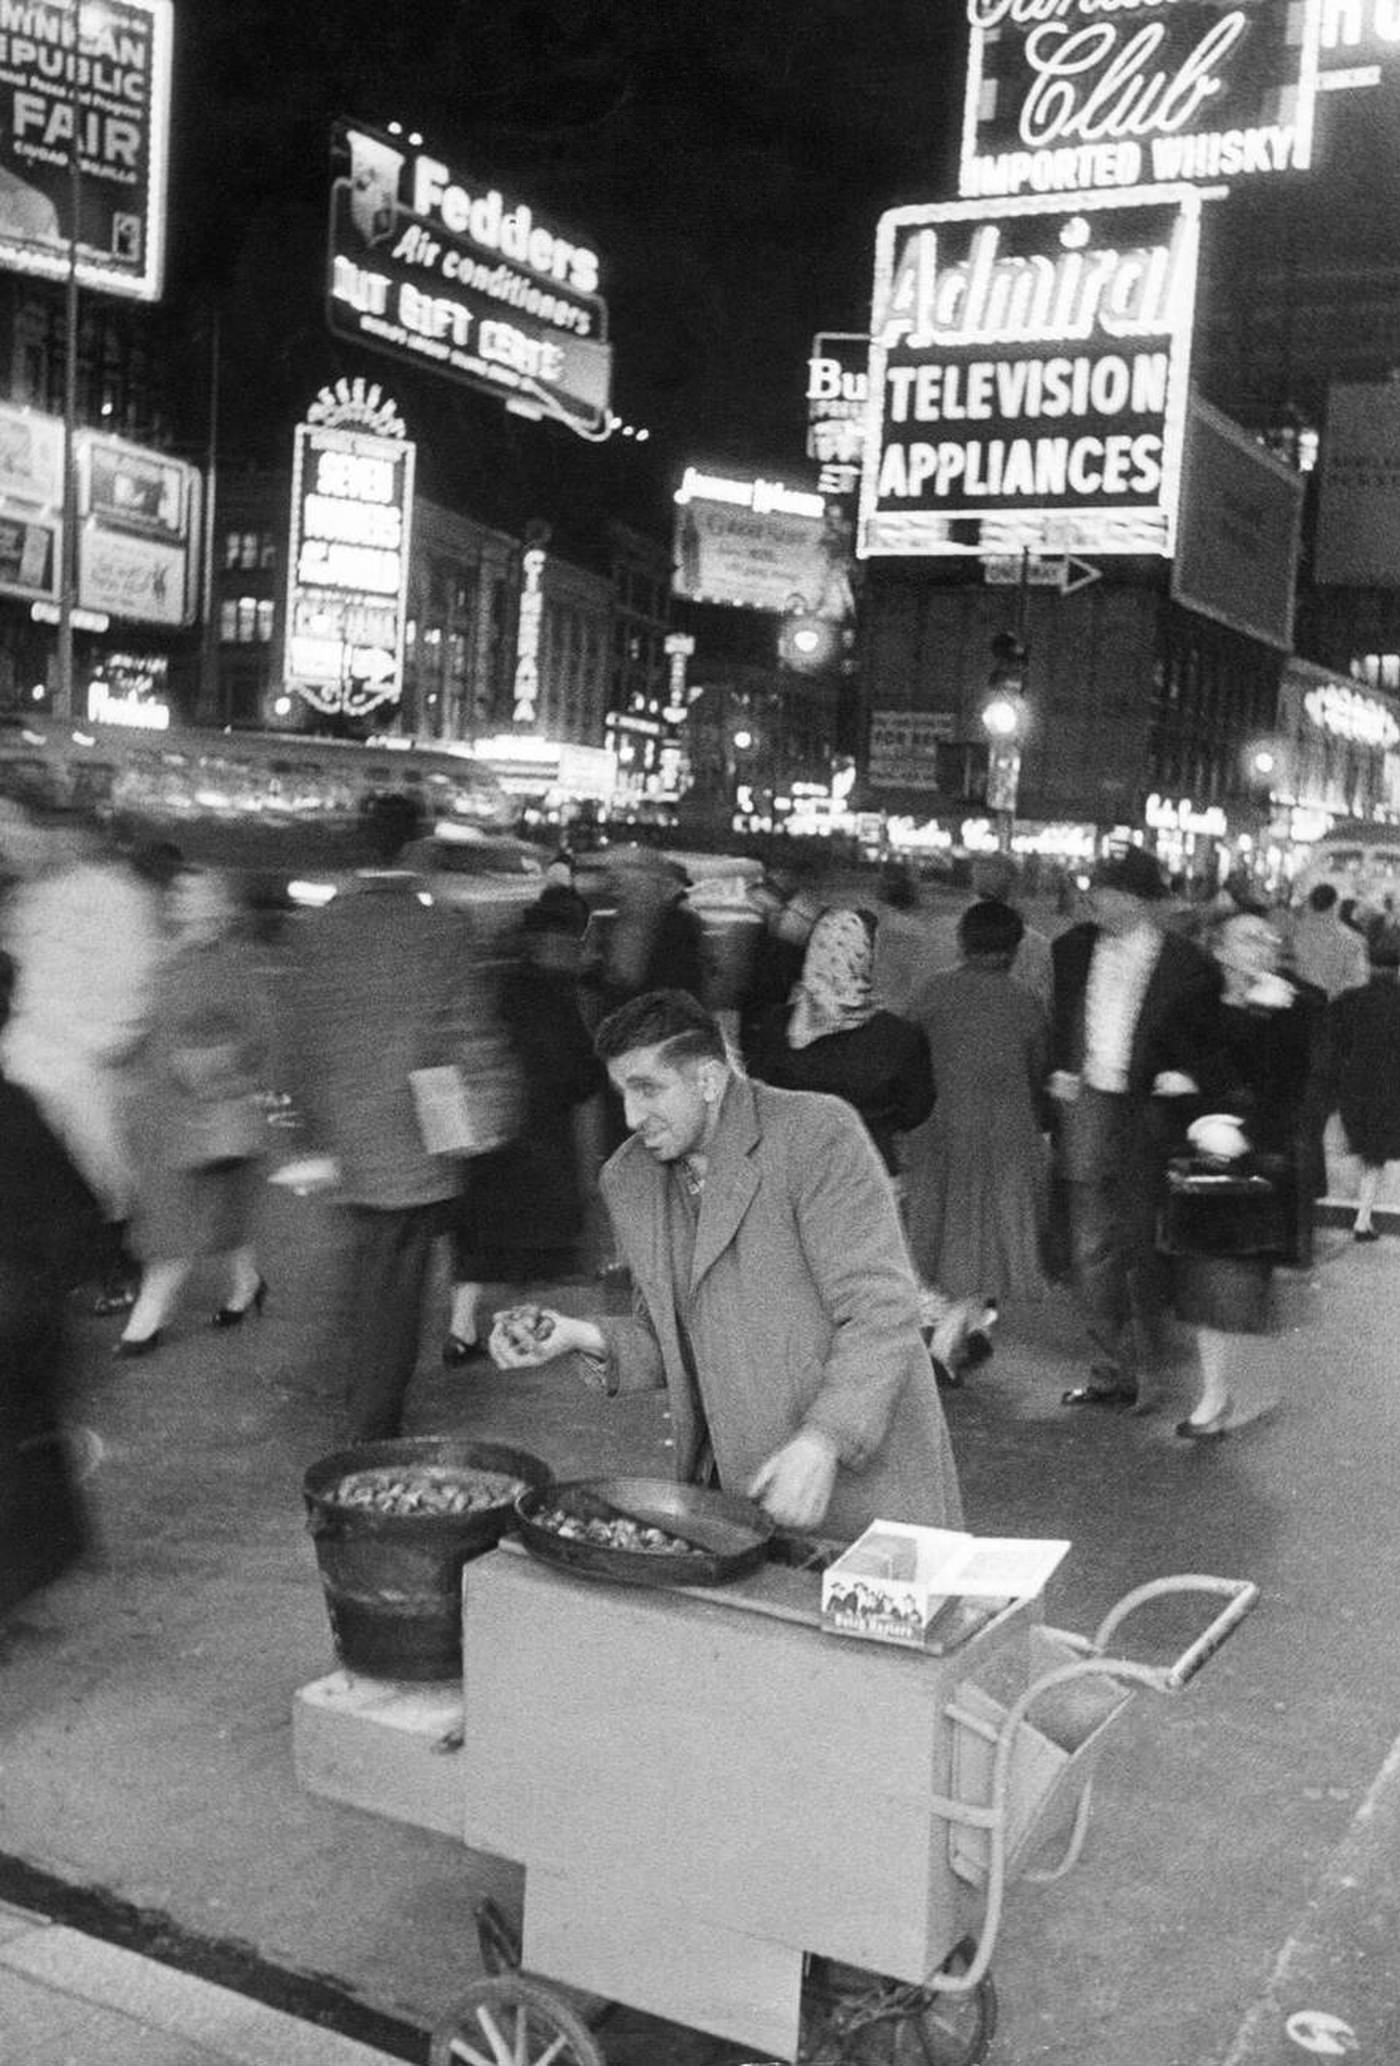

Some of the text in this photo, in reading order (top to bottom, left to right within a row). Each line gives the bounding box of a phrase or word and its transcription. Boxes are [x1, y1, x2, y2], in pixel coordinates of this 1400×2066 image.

[1018, 10, 1246, 146] Club
[13, 91, 141, 166] FAIR
[970, 125, 1298, 196] IMPORTED WHISKY
[413, 155, 600, 293] Fedders
[391, 224, 592, 336] Air conditioners
[880, 214, 1182, 349] Admiral
[887, 352, 1169, 423] TELEVISION
[878, 433, 1164, 498] APPLIANCES
